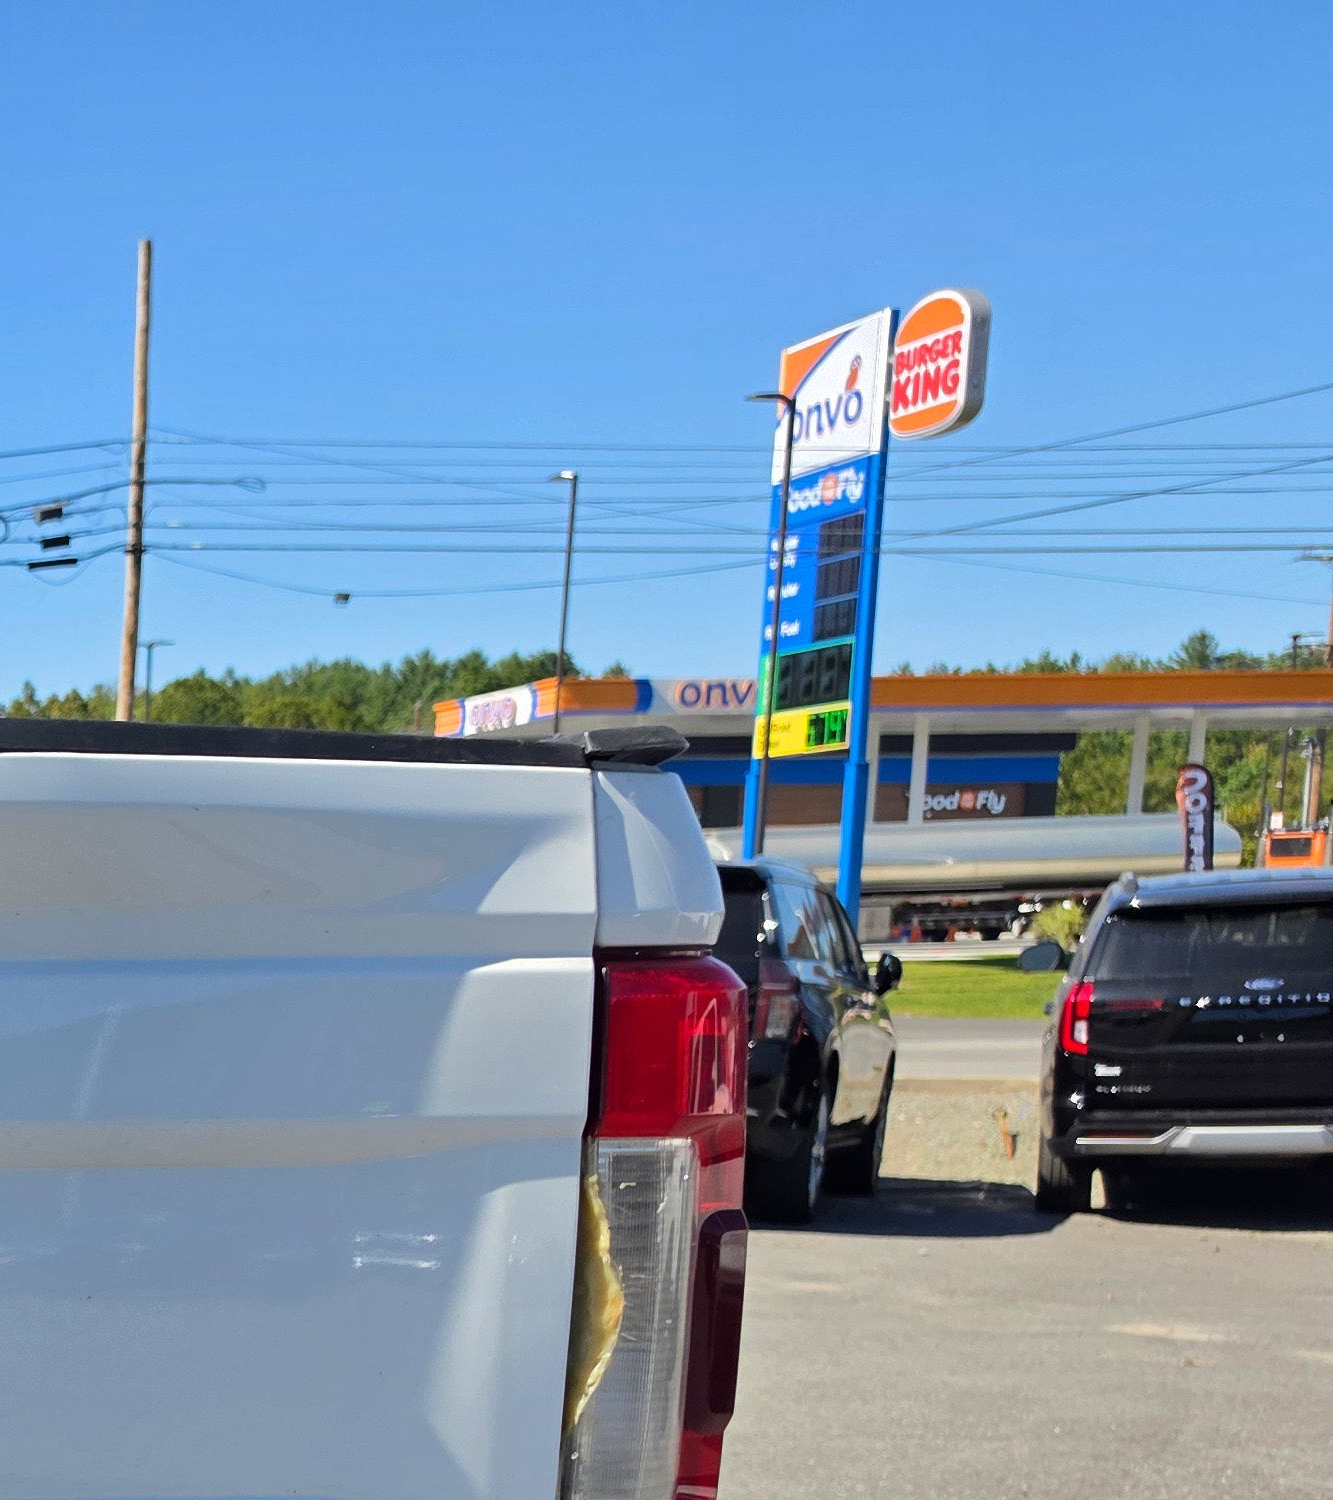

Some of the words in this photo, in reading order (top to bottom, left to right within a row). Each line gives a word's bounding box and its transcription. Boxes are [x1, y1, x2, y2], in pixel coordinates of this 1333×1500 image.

[895, 330, 962, 378] BURGER
[892, 358, 960, 413] KING
[905, 790, 960, 813] ood
[975, 789, 1006, 814] Fly
